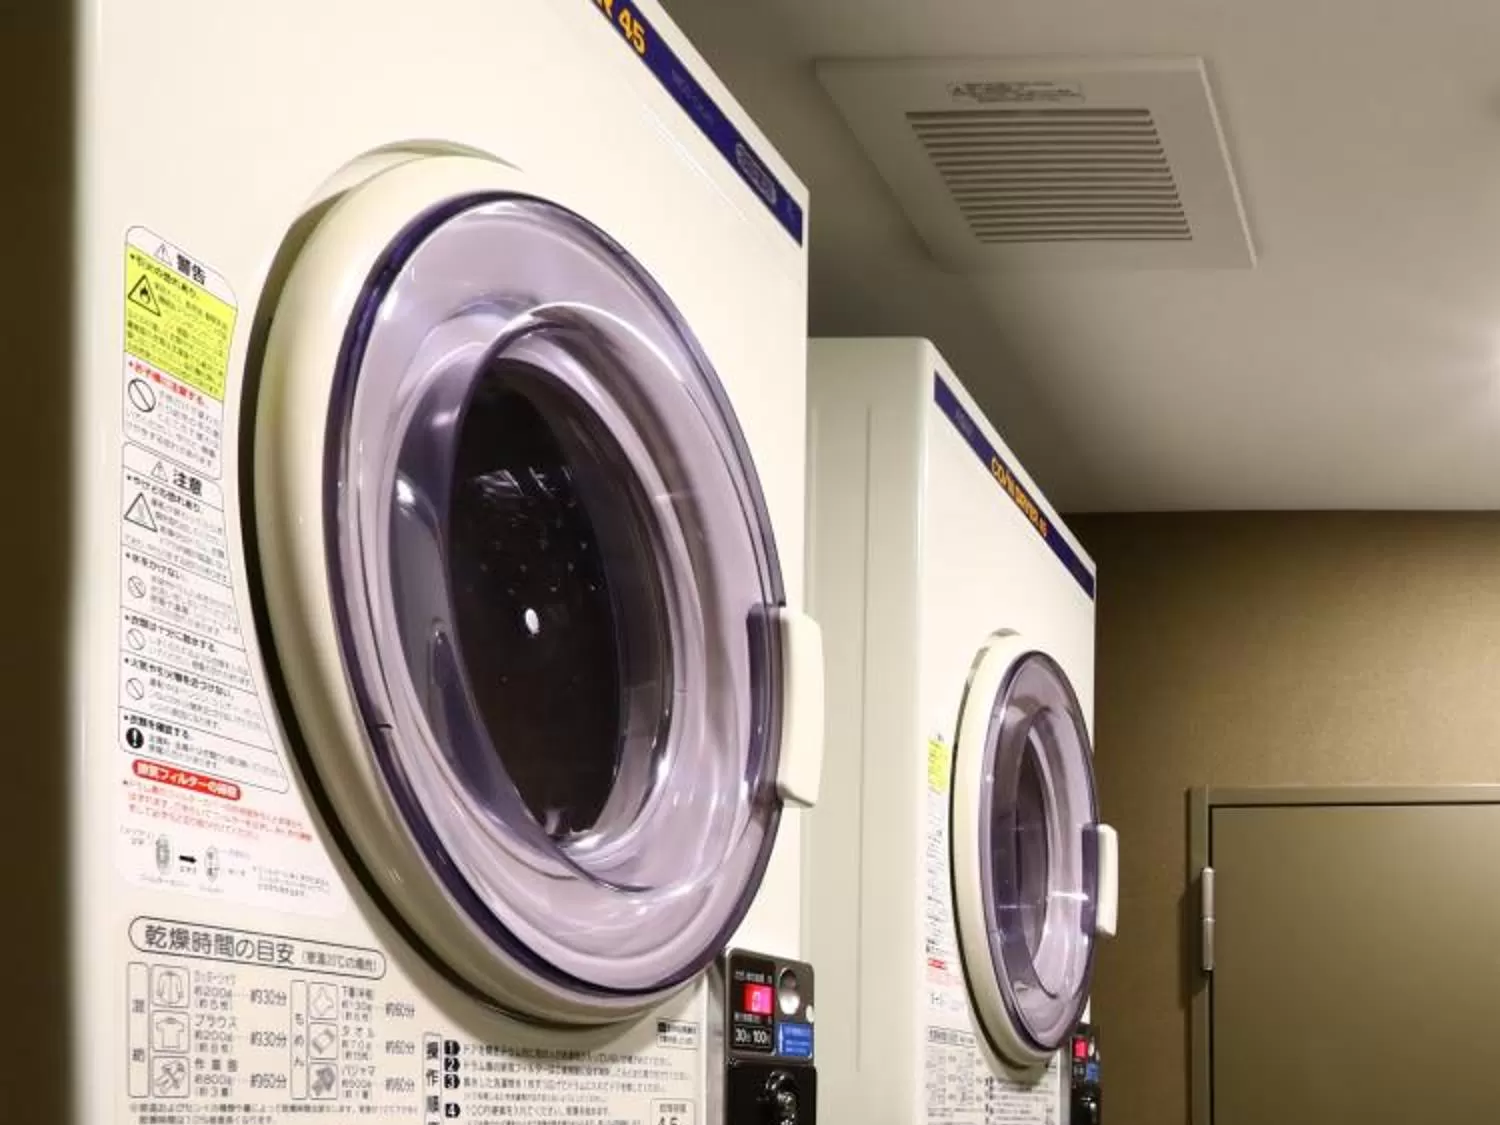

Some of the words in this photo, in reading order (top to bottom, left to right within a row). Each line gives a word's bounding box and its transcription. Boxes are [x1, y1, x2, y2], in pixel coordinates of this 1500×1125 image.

[618, 7, 646, 55] 45
[172, 467, 203, 496] 注意
[144, 923, 296, 966] 乾燥時間の目安
